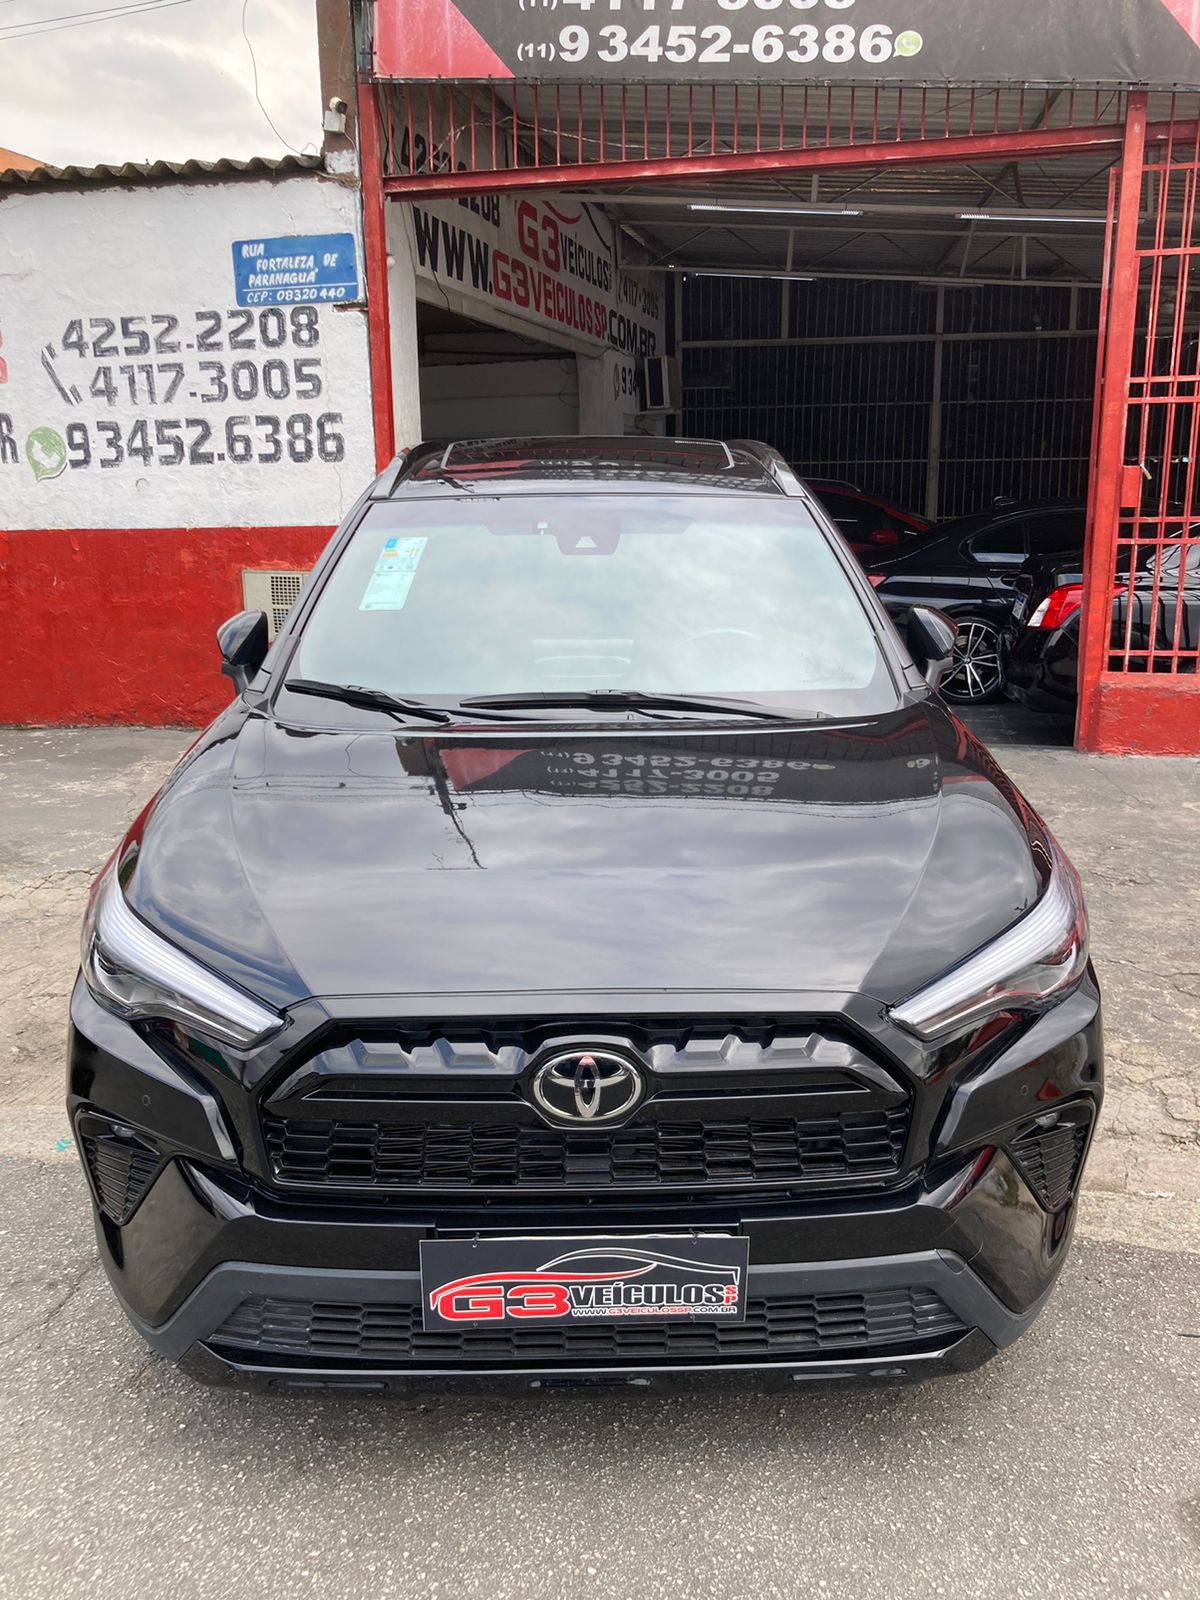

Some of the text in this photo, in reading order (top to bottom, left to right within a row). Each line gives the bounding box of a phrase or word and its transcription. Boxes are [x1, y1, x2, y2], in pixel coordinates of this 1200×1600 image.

[242, 243, 264, 258] RUA
[517, 200, 560, 272] G3
[256, 253, 338, 271] FORTALEZA DE
[247, 291, 273, 303] CEP:
[62, 306, 320, 358] 4252.2208
[89, 357, 322, 406] 4117.3005
[65, 412, 345, 470] 93452.6386
[438, 1285, 570, 1321] G3
[570, 1282, 726, 1307] VEÍCULOS
